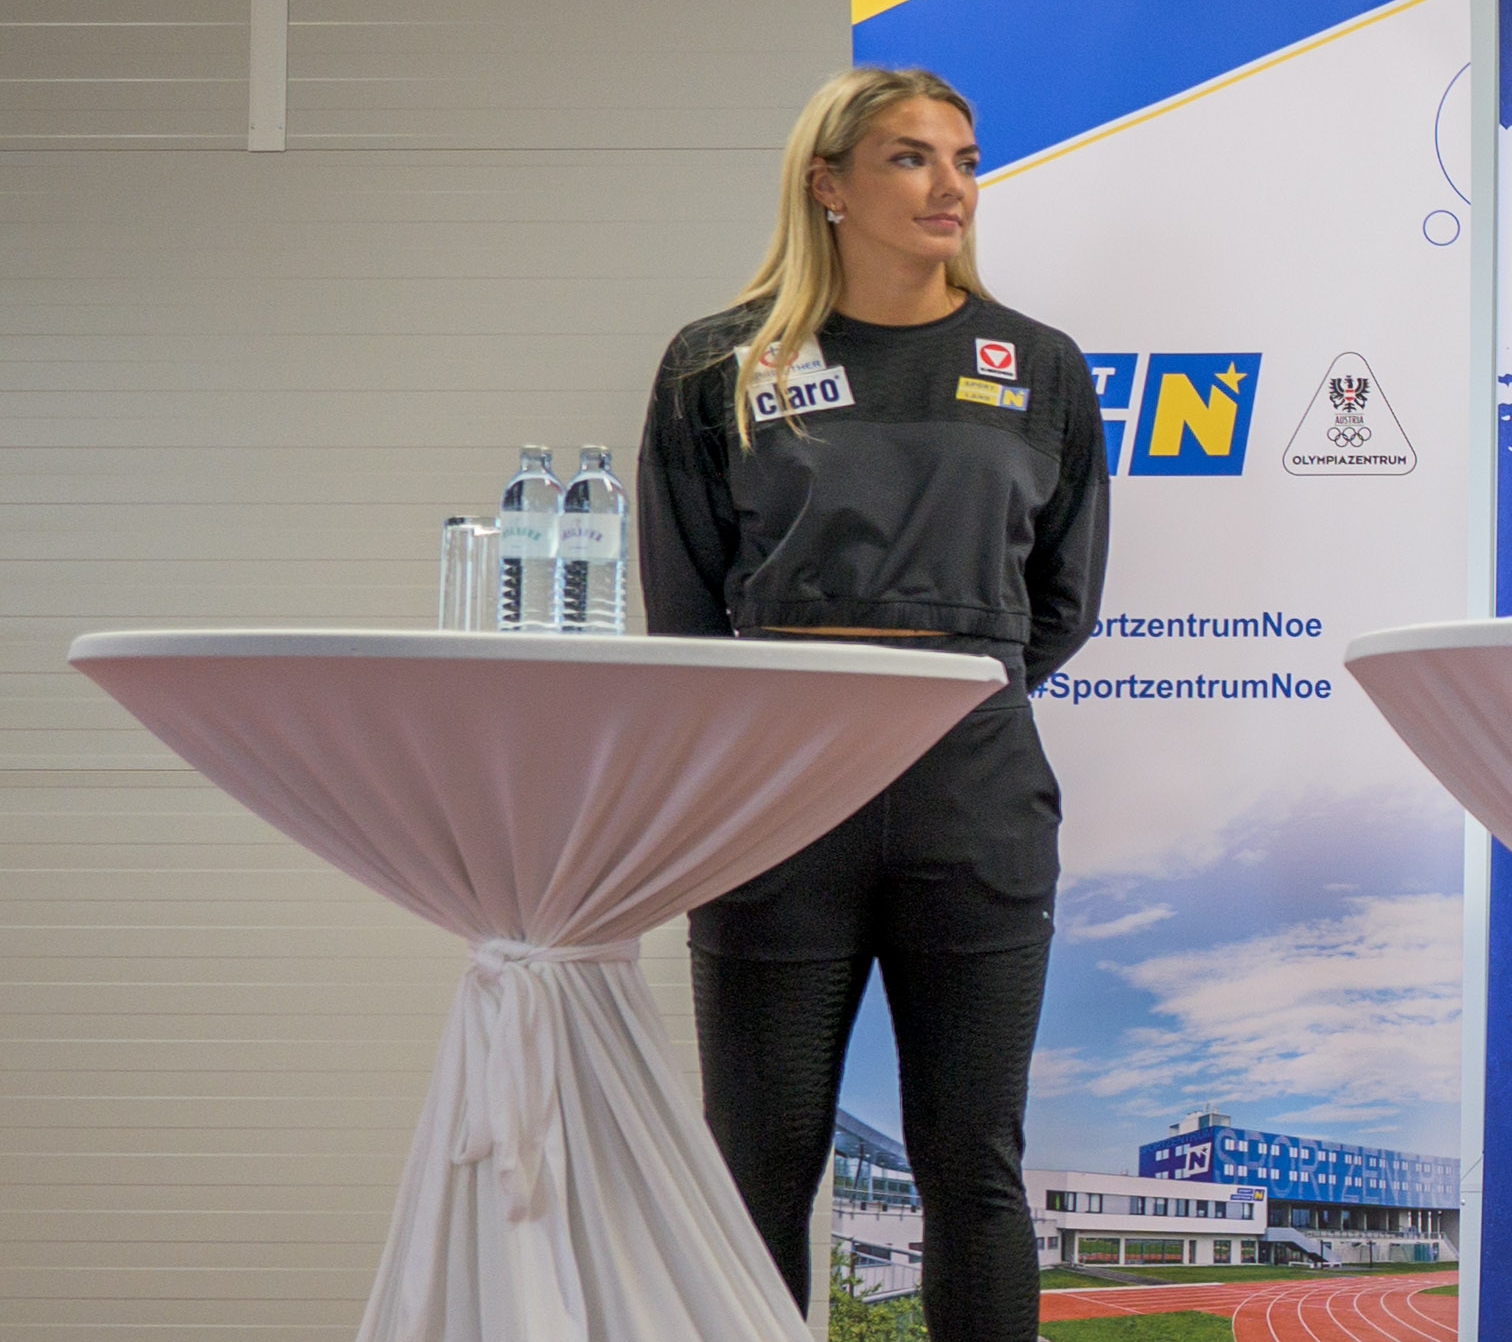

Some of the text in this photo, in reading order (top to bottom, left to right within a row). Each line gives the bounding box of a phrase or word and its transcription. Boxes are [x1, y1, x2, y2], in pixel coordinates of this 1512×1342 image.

[1335, 415, 1364, 425] AUSTRIA
[1292, 455, 1407, 465] OLYMPIAZENTRUM
[1089, 611, 1322, 638] ortzentrumNoe
